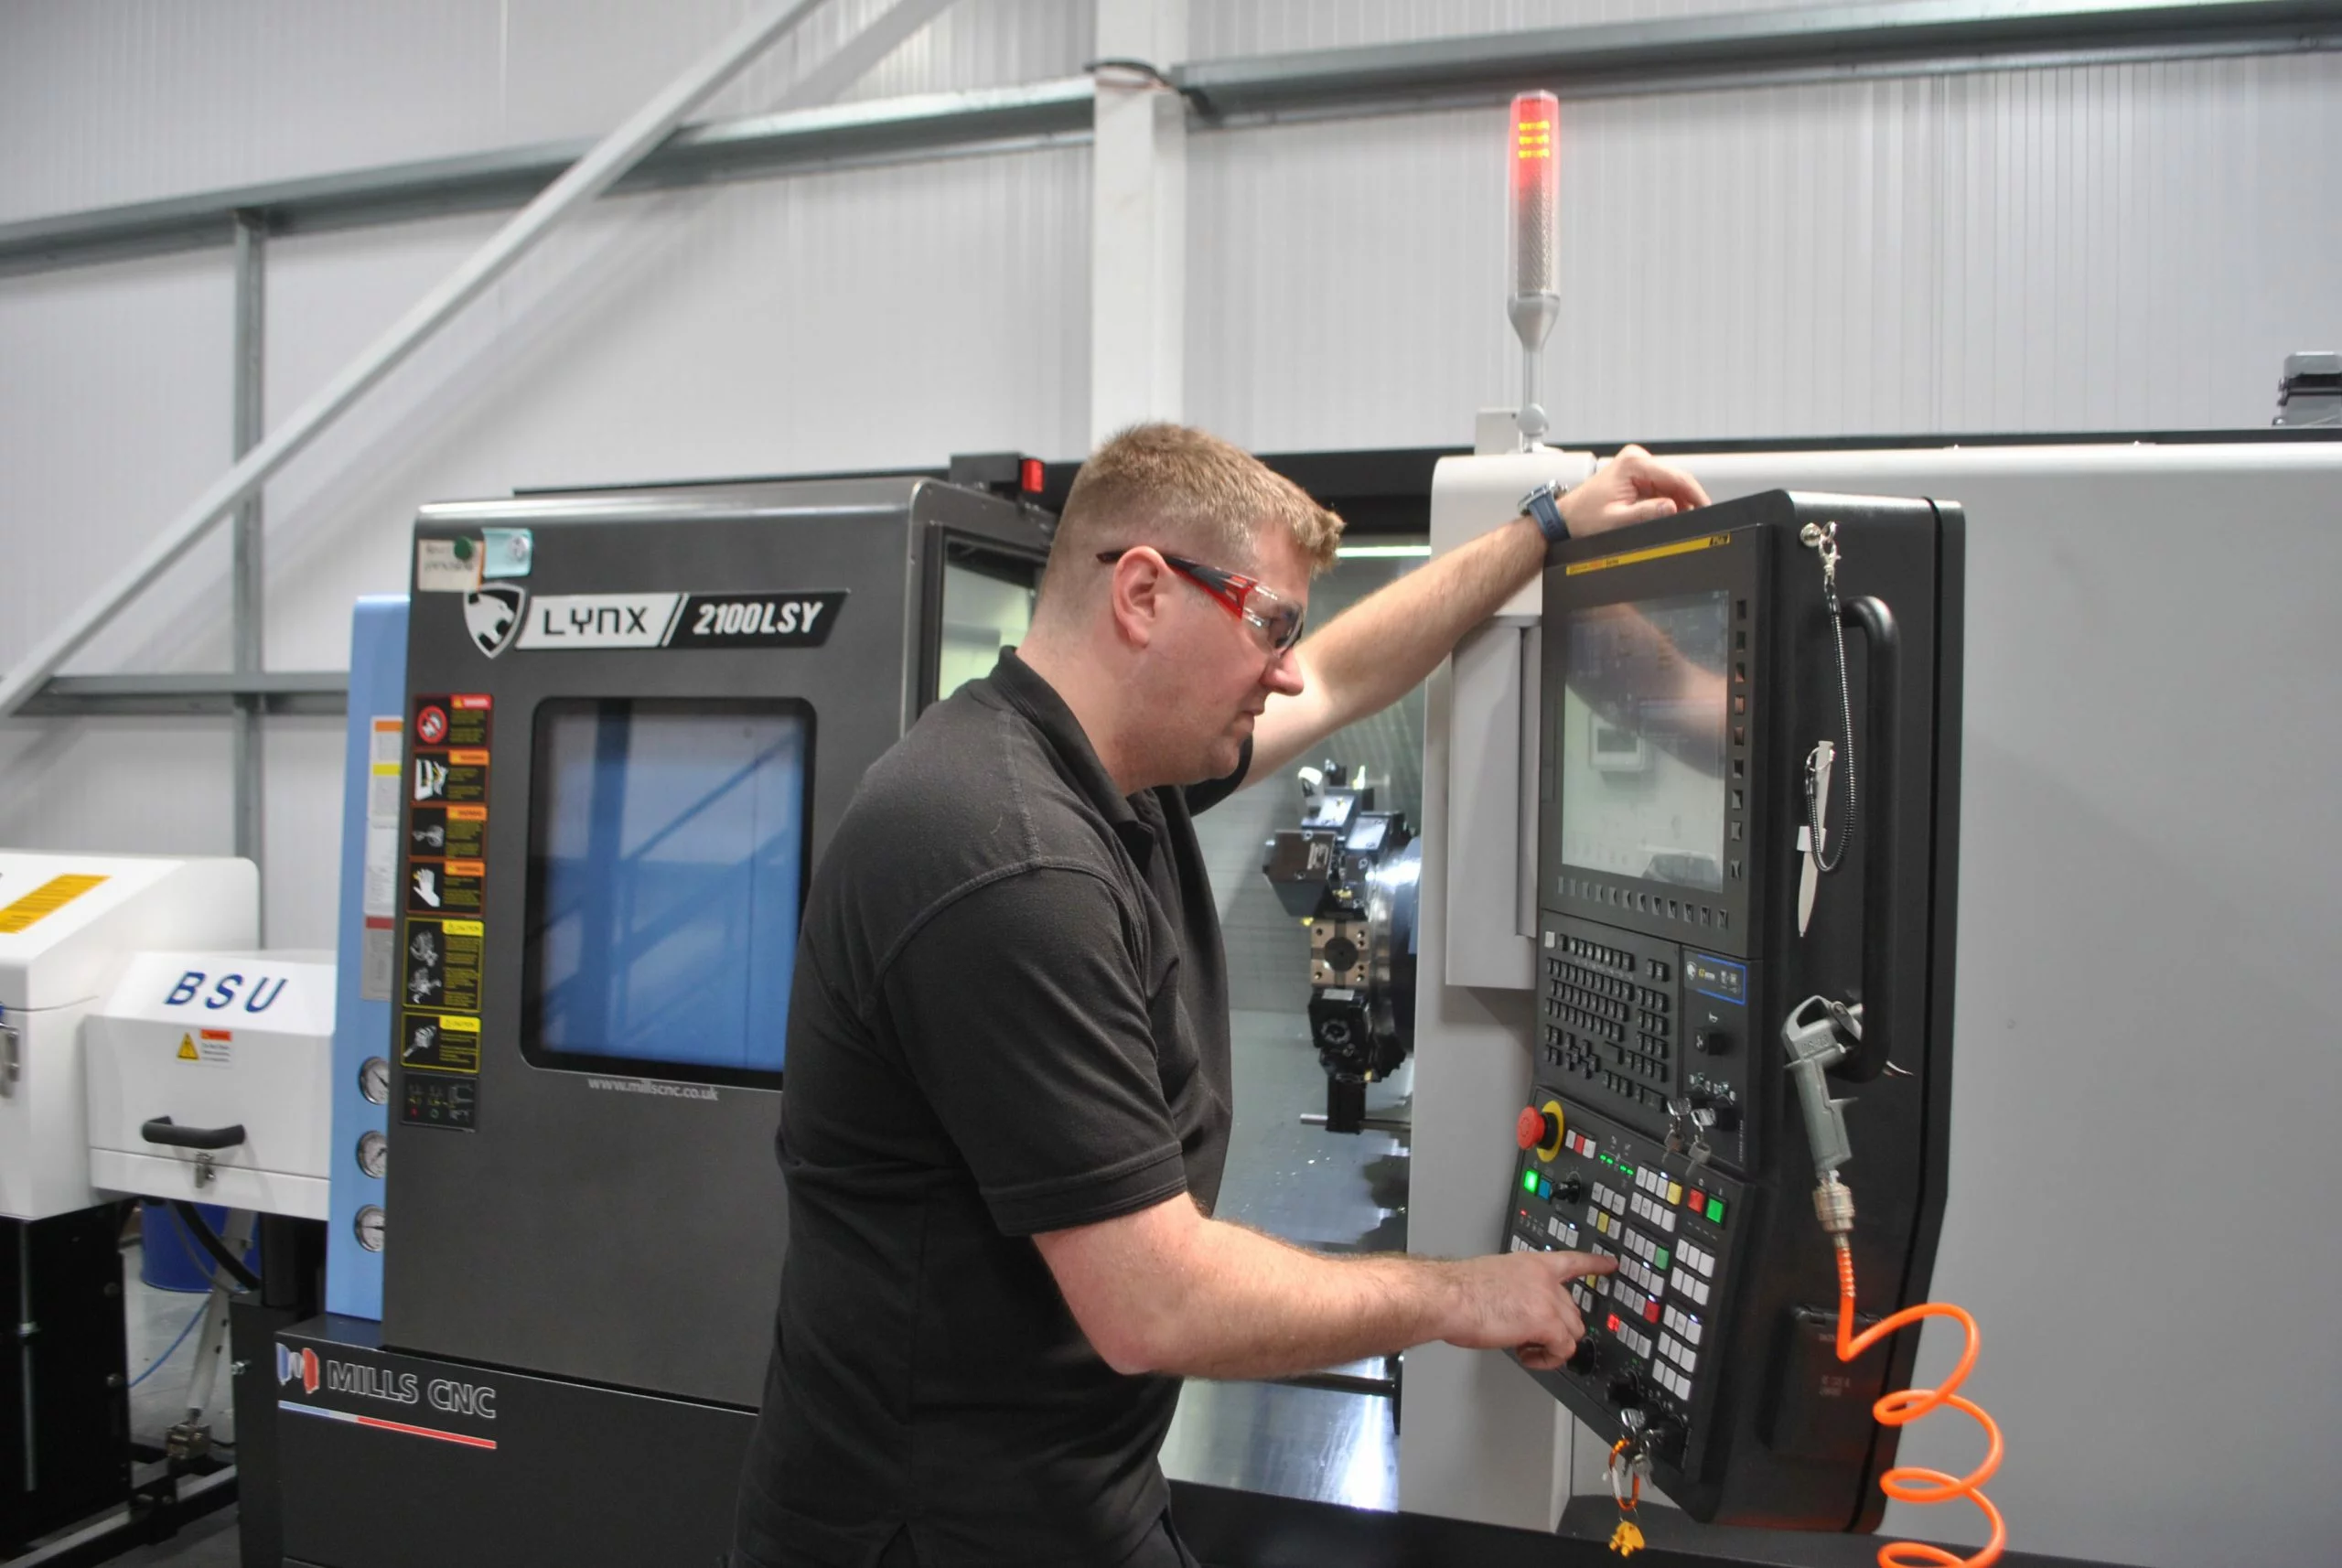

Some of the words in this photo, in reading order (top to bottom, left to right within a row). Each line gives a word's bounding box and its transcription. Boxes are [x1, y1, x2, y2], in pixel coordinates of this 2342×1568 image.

[543, 607, 648, 636] LYNX
[693, 602, 822, 635] 2100LSY
[164, 972, 288, 1013] BSU
[587, 1079, 718, 1101] www.millscnc.co.uk
[327, 1359, 419, 1404] MILLS
[427, 1379, 496, 1419] CNC
